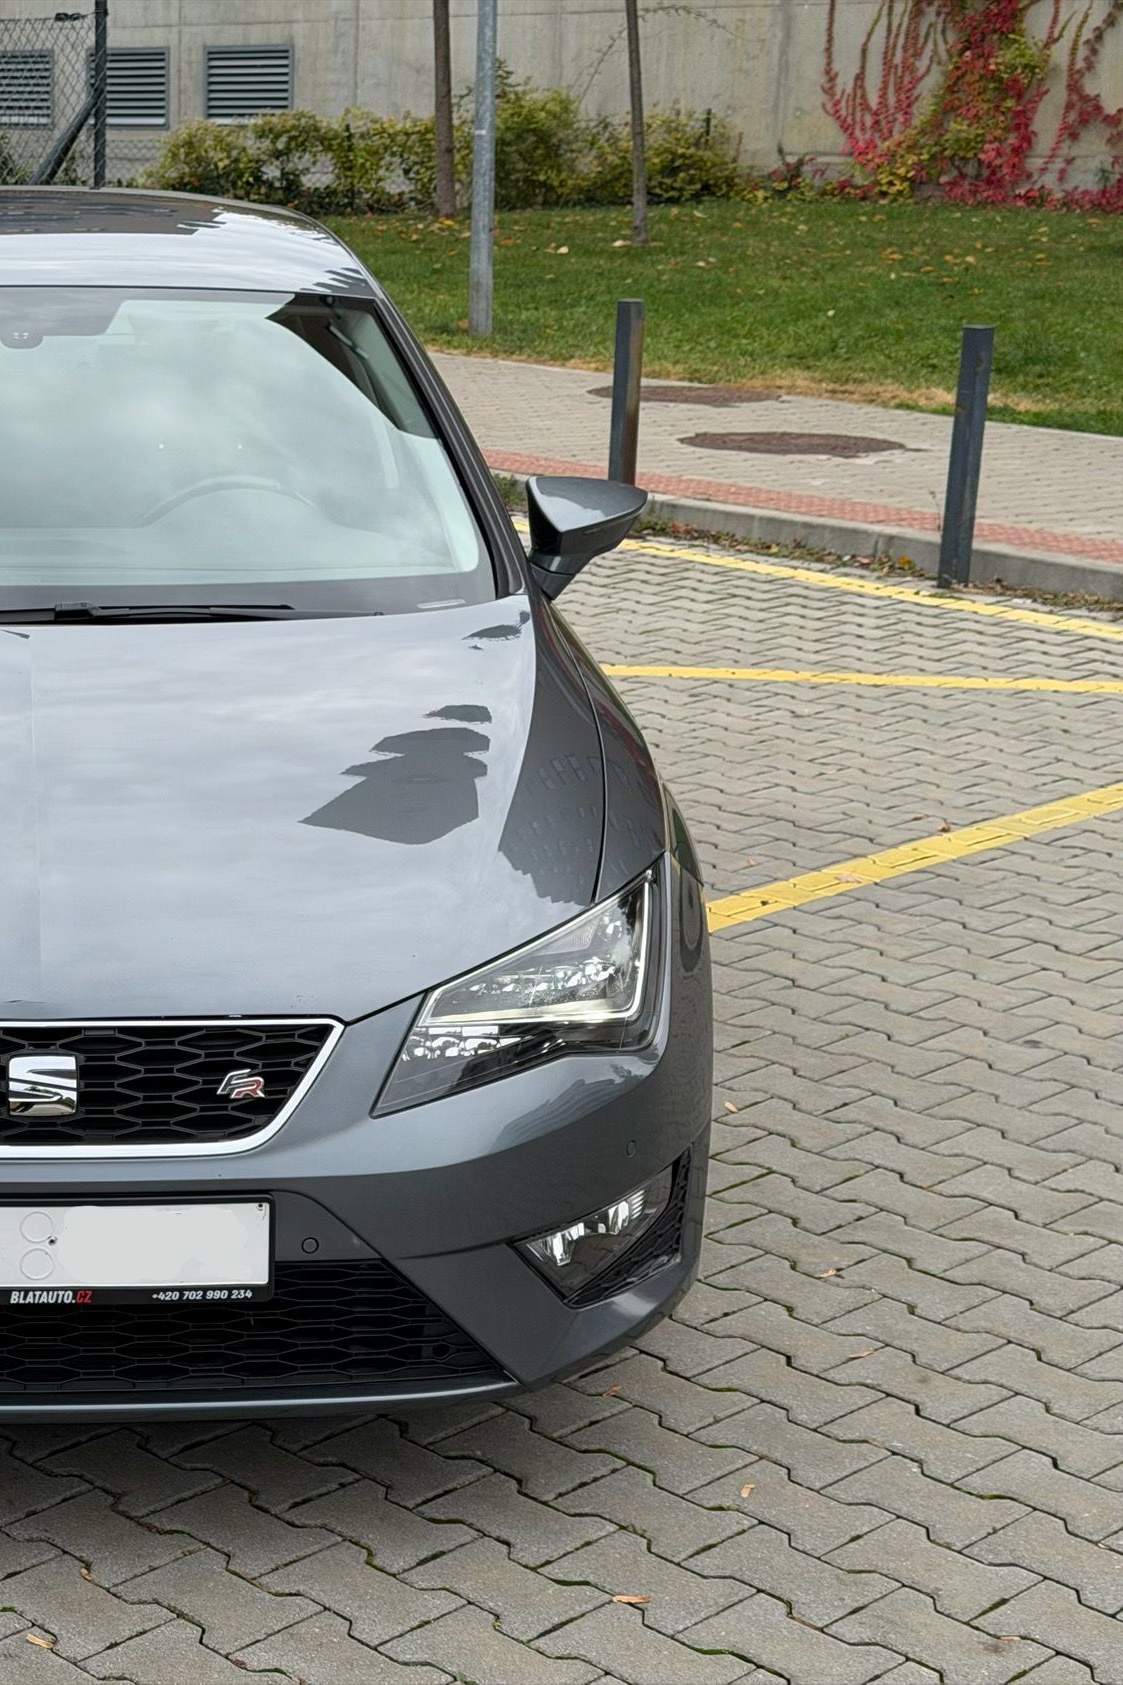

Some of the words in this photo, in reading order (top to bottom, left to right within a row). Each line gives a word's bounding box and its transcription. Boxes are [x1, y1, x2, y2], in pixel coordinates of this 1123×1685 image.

[216, 1068, 265, 1099] FR
[10, 1291, 93, 1304] BLATAUTO.CZ
[151, 1291, 179, 1301] +420
[182, 1290, 203, 1300] 702
[206, 1290, 228, 1300] 990
[231, 1290, 253, 1299] 234
